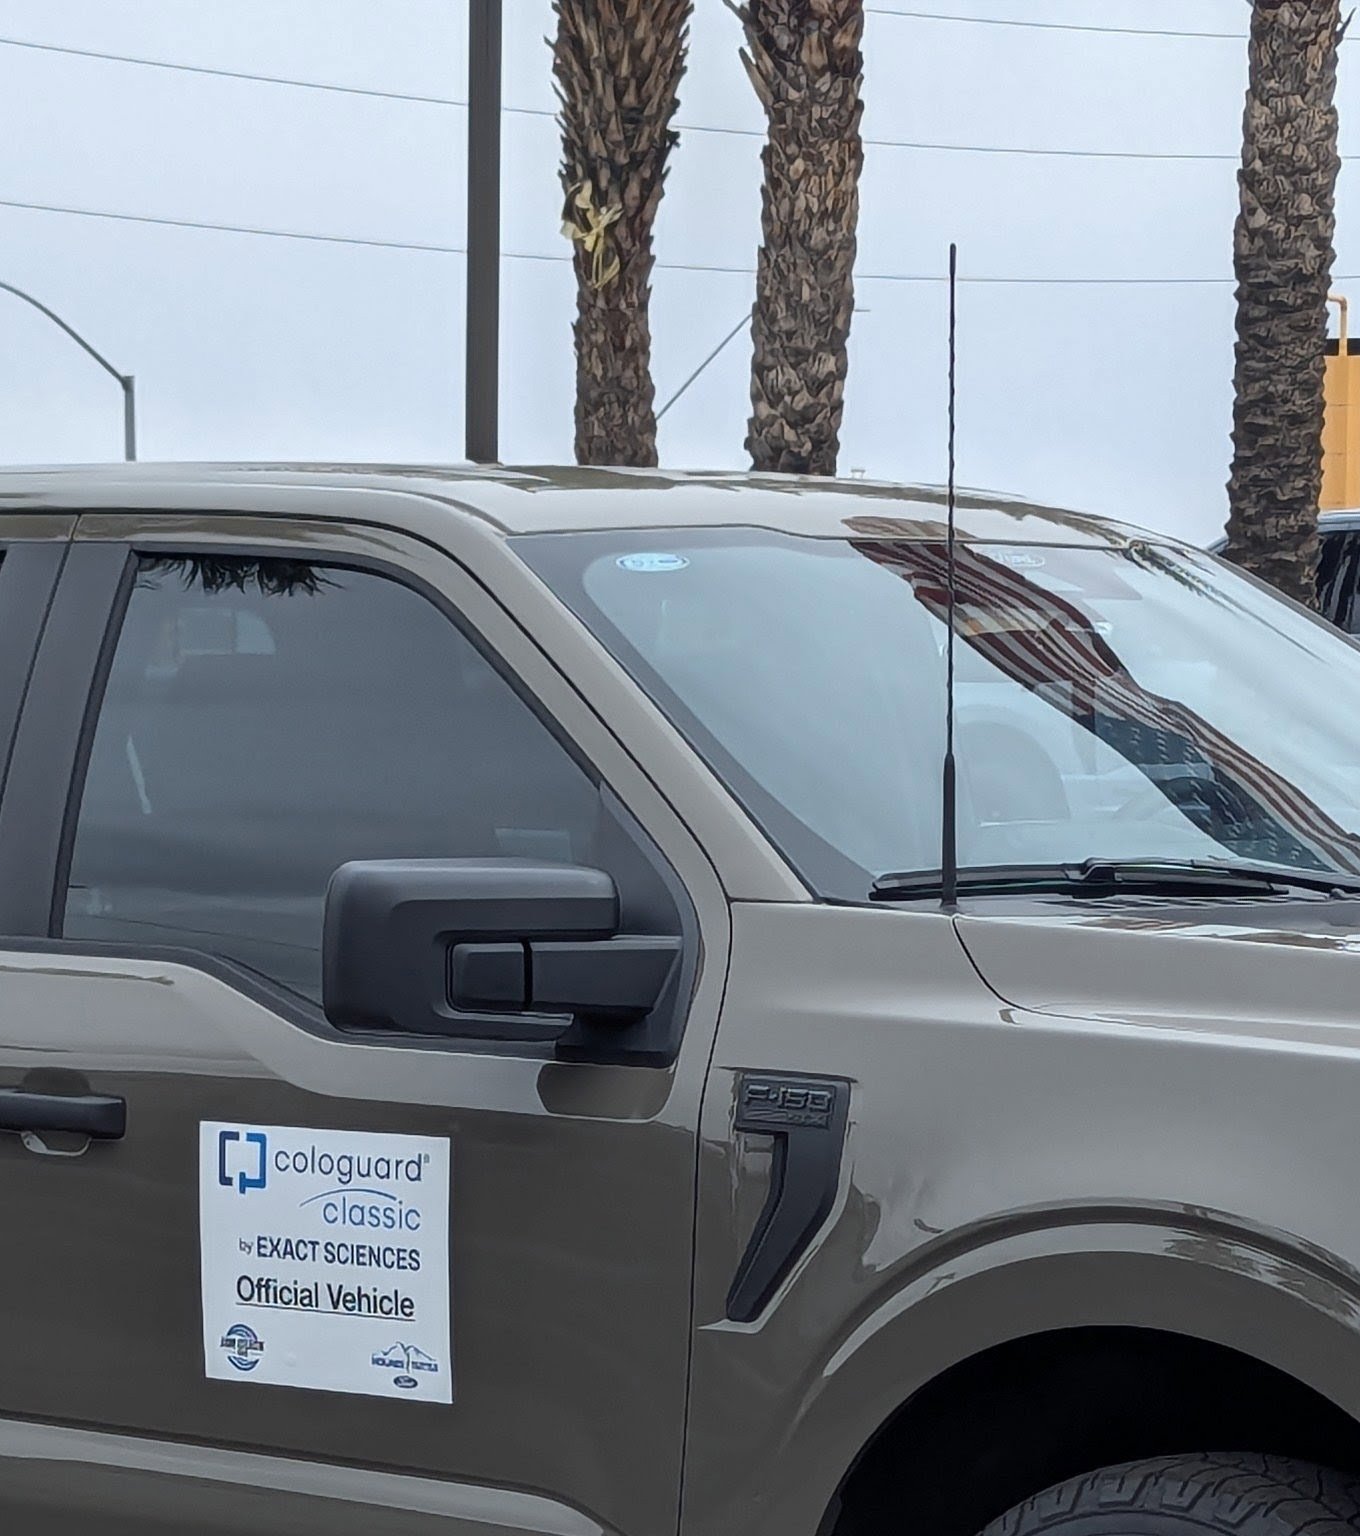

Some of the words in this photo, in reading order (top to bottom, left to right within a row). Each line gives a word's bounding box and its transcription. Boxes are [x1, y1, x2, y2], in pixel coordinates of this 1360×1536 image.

[274, 1145, 423, 1185] cologuard
[323, 1196, 421, 1231] classic
[239, 1237, 254, 1255] by
[257, 1235, 320, 1262] EXACT
[324, 1241, 421, 1271] SCIENCES
[236, 1275, 319, 1308] Official
[326, 1282, 416, 1317] Vehicle
